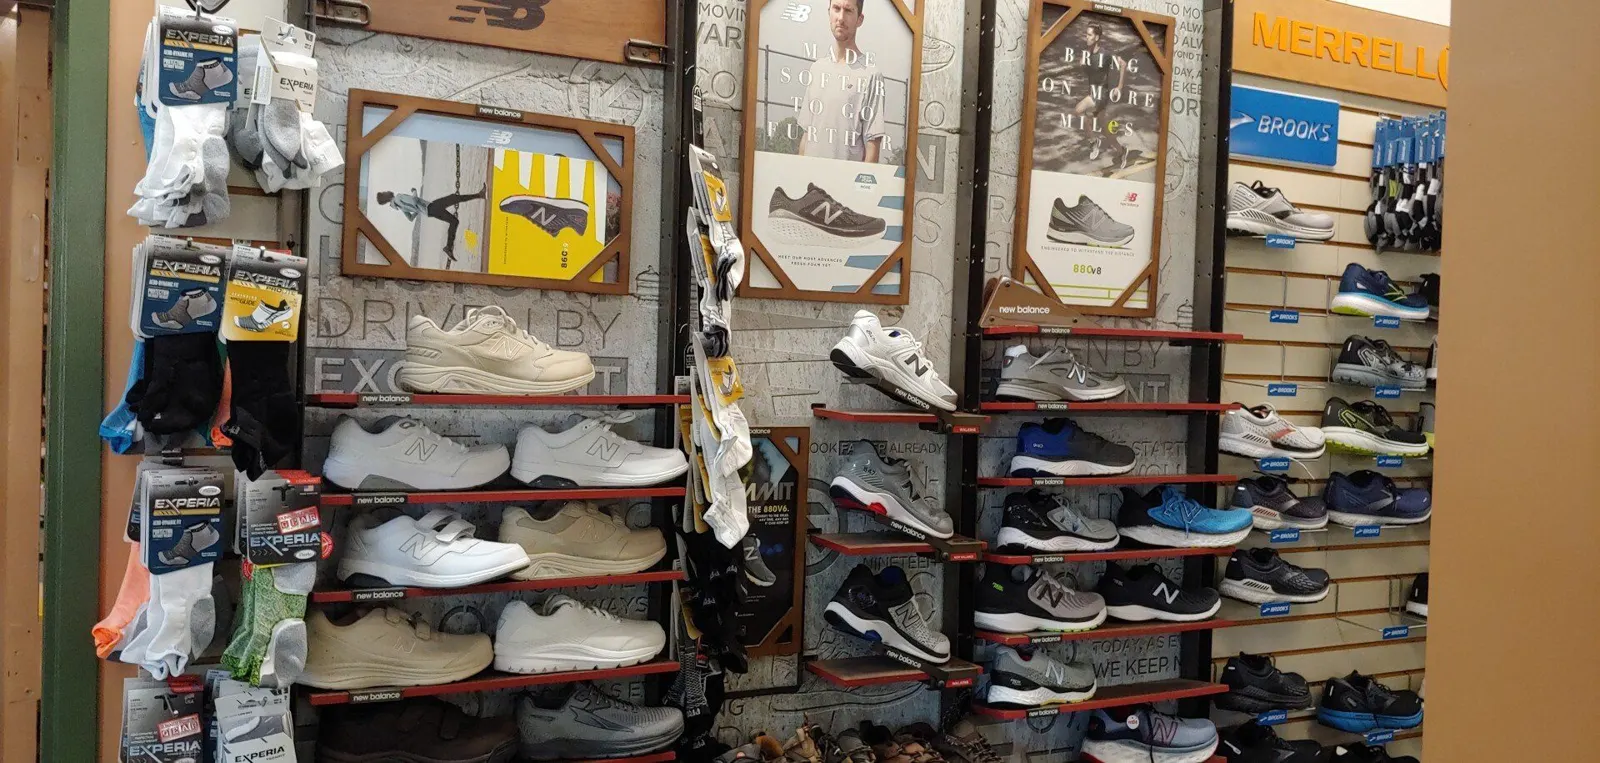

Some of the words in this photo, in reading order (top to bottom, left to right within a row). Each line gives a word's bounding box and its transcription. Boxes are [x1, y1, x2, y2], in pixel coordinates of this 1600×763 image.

[1183, 6, 1203, 20] MO
[165, 28, 234, 48] EXPERIA
[1252, 12, 1437, 81] MERRELL
[804, 41, 877, 67] MADE
[1064, 47, 1139, 74] BRING
[280, 77, 315, 92] EXPERIA
[779, 67, 886, 97] SOFTER
[1041, 77, 1072, 96] ON
[1090, 84, 1156, 108] MORE
[494, 107, 522, 118] balance
[790, 96, 824, 116] TO
[841, 103, 875, 122] GO
[1257, 115, 1332, 142] BROOKS
[152, 258, 221, 277] EXPERIA
[234, 269, 299, 290] EXPERIA
[1017, 305, 1050, 314] balance
[556, 309, 621, 349] BY
[380, 394, 410, 402] balance
[894, 388, 907, 398] new
[907, 395, 931, 410] balance
[154, 497, 221, 514] EXPERIA
[374, 495, 405, 503] balance
[891, 522, 903, 530] new
[903, 527, 926, 541] balance
[250, 533, 321, 554] EXPERIA
[373, 591, 404, 599] balance
[887, 650, 899, 658] new
[899, 655, 922, 669] balance
[1092, 660, 1121, 679] WE
[370, 692, 400, 701] balance
[129, 740, 202, 763] EXPERIA
[235, 746, 285, 763] EXPERIA
